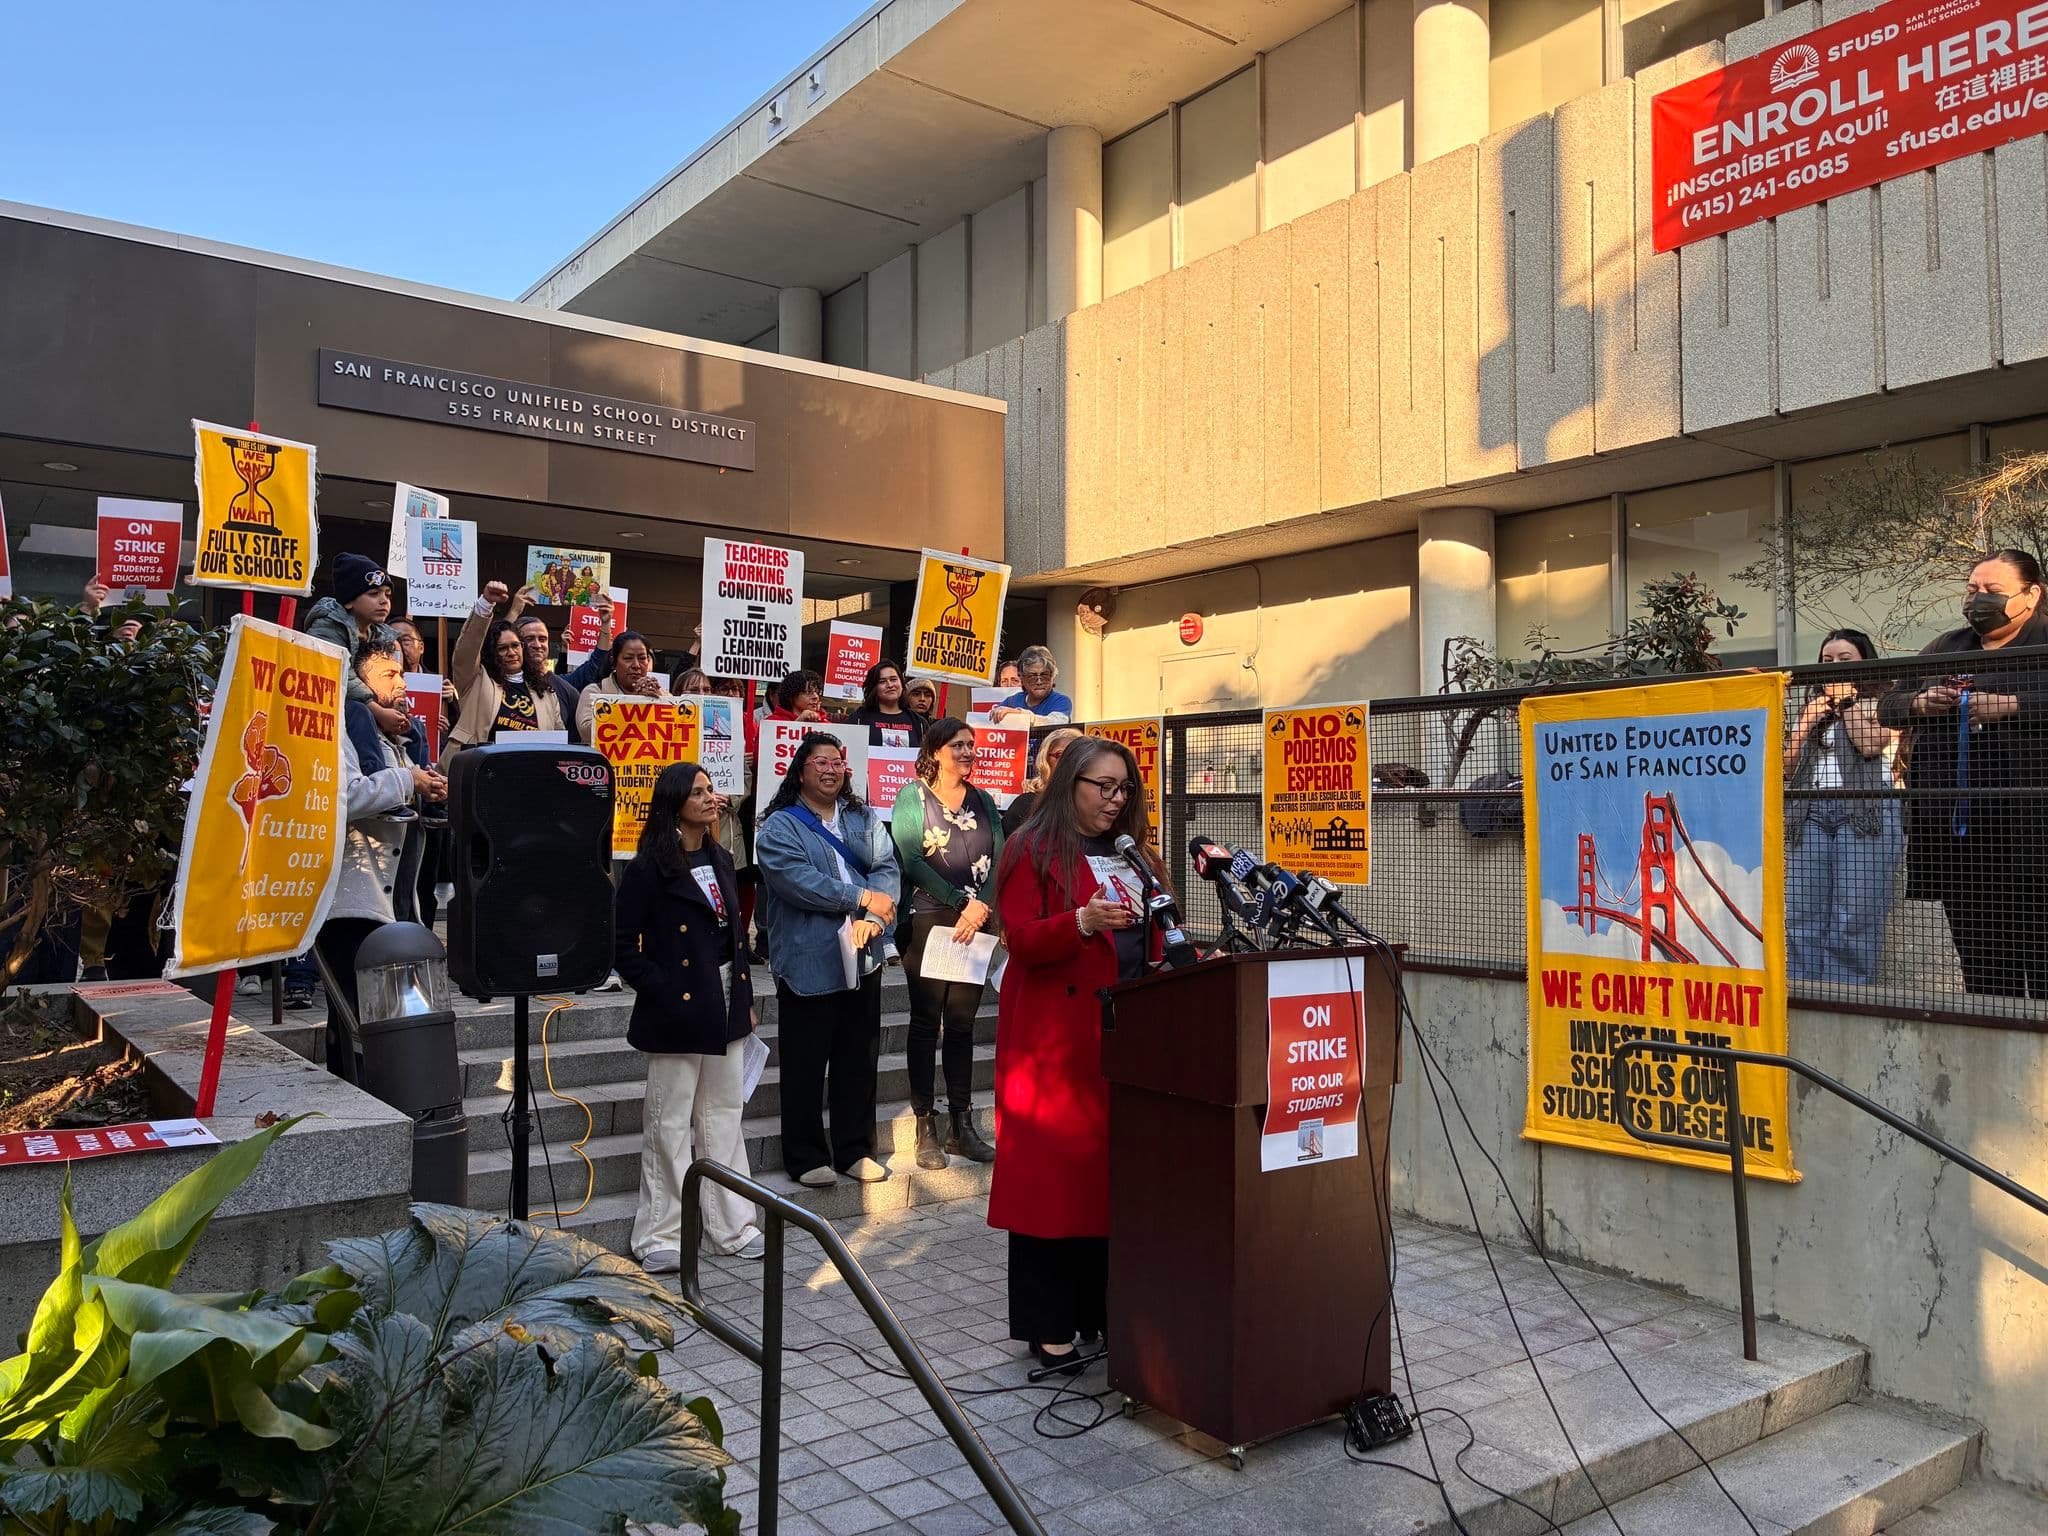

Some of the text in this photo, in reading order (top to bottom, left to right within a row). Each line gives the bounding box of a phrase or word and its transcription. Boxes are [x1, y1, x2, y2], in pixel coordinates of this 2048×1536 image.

[1905, 1, 1981, 34] PUBLIC SCHOOLS
[1905, 12, 1924, 25] SAN
[1828, 23, 1900, 62] SFUSD
[1692, 3, 2048, 166] ENROLL HERE
[1667, 106, 1889, 207] ¡INSCRÍBETE AQUÍ!
[1682, 153, 1850, 228] (415) 241-6085
[333, 360, 747, 442] SAN FRANCISCO UNIFIED SCHOOL DISTRICT
[448, 401, 657, 447] 555 FRANKLIN STREET
[243, 450, 265, 462] WE
[237, 460, 271, 479] CAN'T
[232, 506, 271, 524] WAIT
[128, 522, 153, 535] ON
[114, 539, 166, 554] STRIKE
[207, 529, 298, 559] FULLY STAFF
[118, 554, 160, 564] FOR SPED
[568, 553, 606, 564] SANTUARIO
[724, 543, 789, 568] TEACHERS
[113, 564, 164, 574] STUDENTS &
[200, 551, 303, 581] OUR SCHOOLS
[424, 563, 463, 577] UESF
[725, 562, 785, 586] WORKING
[111, 574, 161, 583] EDUCATORS
[408, 578, 443, 590] Raises
[949, 581, 975, 594] CAN'T
[955, 574, 972, 583] WE
[718, 580, 794, 605] CONDITIONS
[581, 615, 617, 629] STRE
[723, 619, 787, 641] STUDENTS
[945, 615, 971, 629] WAIT
[582, 629, 597, 637] FOR
[722, 637, 784, 660] LEARNING
[847, 638, 863, 649] ON
[921, 631, 986, 657] FULLY STAFF
[838, 649, 871, 662] STRIKE
[916, 647, 986, 673] OUR SCHOOLS
[715, 656, 790, 678] CONDITIONS
[836, 666, 863, 675] STUDENTS
[278, 665, 337, 708] CAN'T
[285, 704, 335, 742] WAIT
[497, 716, 511, 726] WE
[619, 703, 676, 723] WE
[597, 723, 696, 742] CAN'T
[1293, 714, 1341, 739] NO
[987, 732, 1006, 743] ON
[1105, 728, 1142, 747] WE
[1545, 724, 1752, 755] UNITED EDUCATORS
[599, 742, 688, 761] WAIT
[975, 747, 1015, 759] STRIKE
[1283, 736, 1357, 765] PODEMOS
[311, 758, 333, 783] for
[566, 765, 606, 781] 800
[623, 764, 632, 775] IN
[635, 764, 651, 776] THE
[887, 763, 905, 773] ON
[975, 769, 1008, 777] STUDENTS
[978, 760, 1011, 769] FOR SPED
[1550, 753, 1747, 782] OF SAN FRANCISCO
[615, 777, 654, 788] TUDENTS
[973, 778, 1013, 787] EDUCATORS
[1287, 764, 1353, 792] ESPERAR
[305, 788, 330, 812] the
[1270, 800, 1366, 813] NUESTROS ESTUDIANTES MERECEN
[1273, 790, 1362, 803] INVIERTA EN LAS ESCUELAS QUE
[258, 813, 328, 840] future
[287, 848, 325, 869] our
[241, 868, 316, 900] sdents
[1541, 969, 1764, 1028] WE CAN'T WAIT
[1302, 1005, 1331, 1028] ON
[1287, 1037, 1347, 1064] STRIKE
[1569, 1020, 1732, 1069] INVEST IN THE
[1291, 1073, 1343, 1092] FOR OUR
[1681, 1066, 1729, 1107] OUR
[1286, 1093, 1343, 1114] STUDENTS
[22, 1135, 60, 1157] STRIKE
